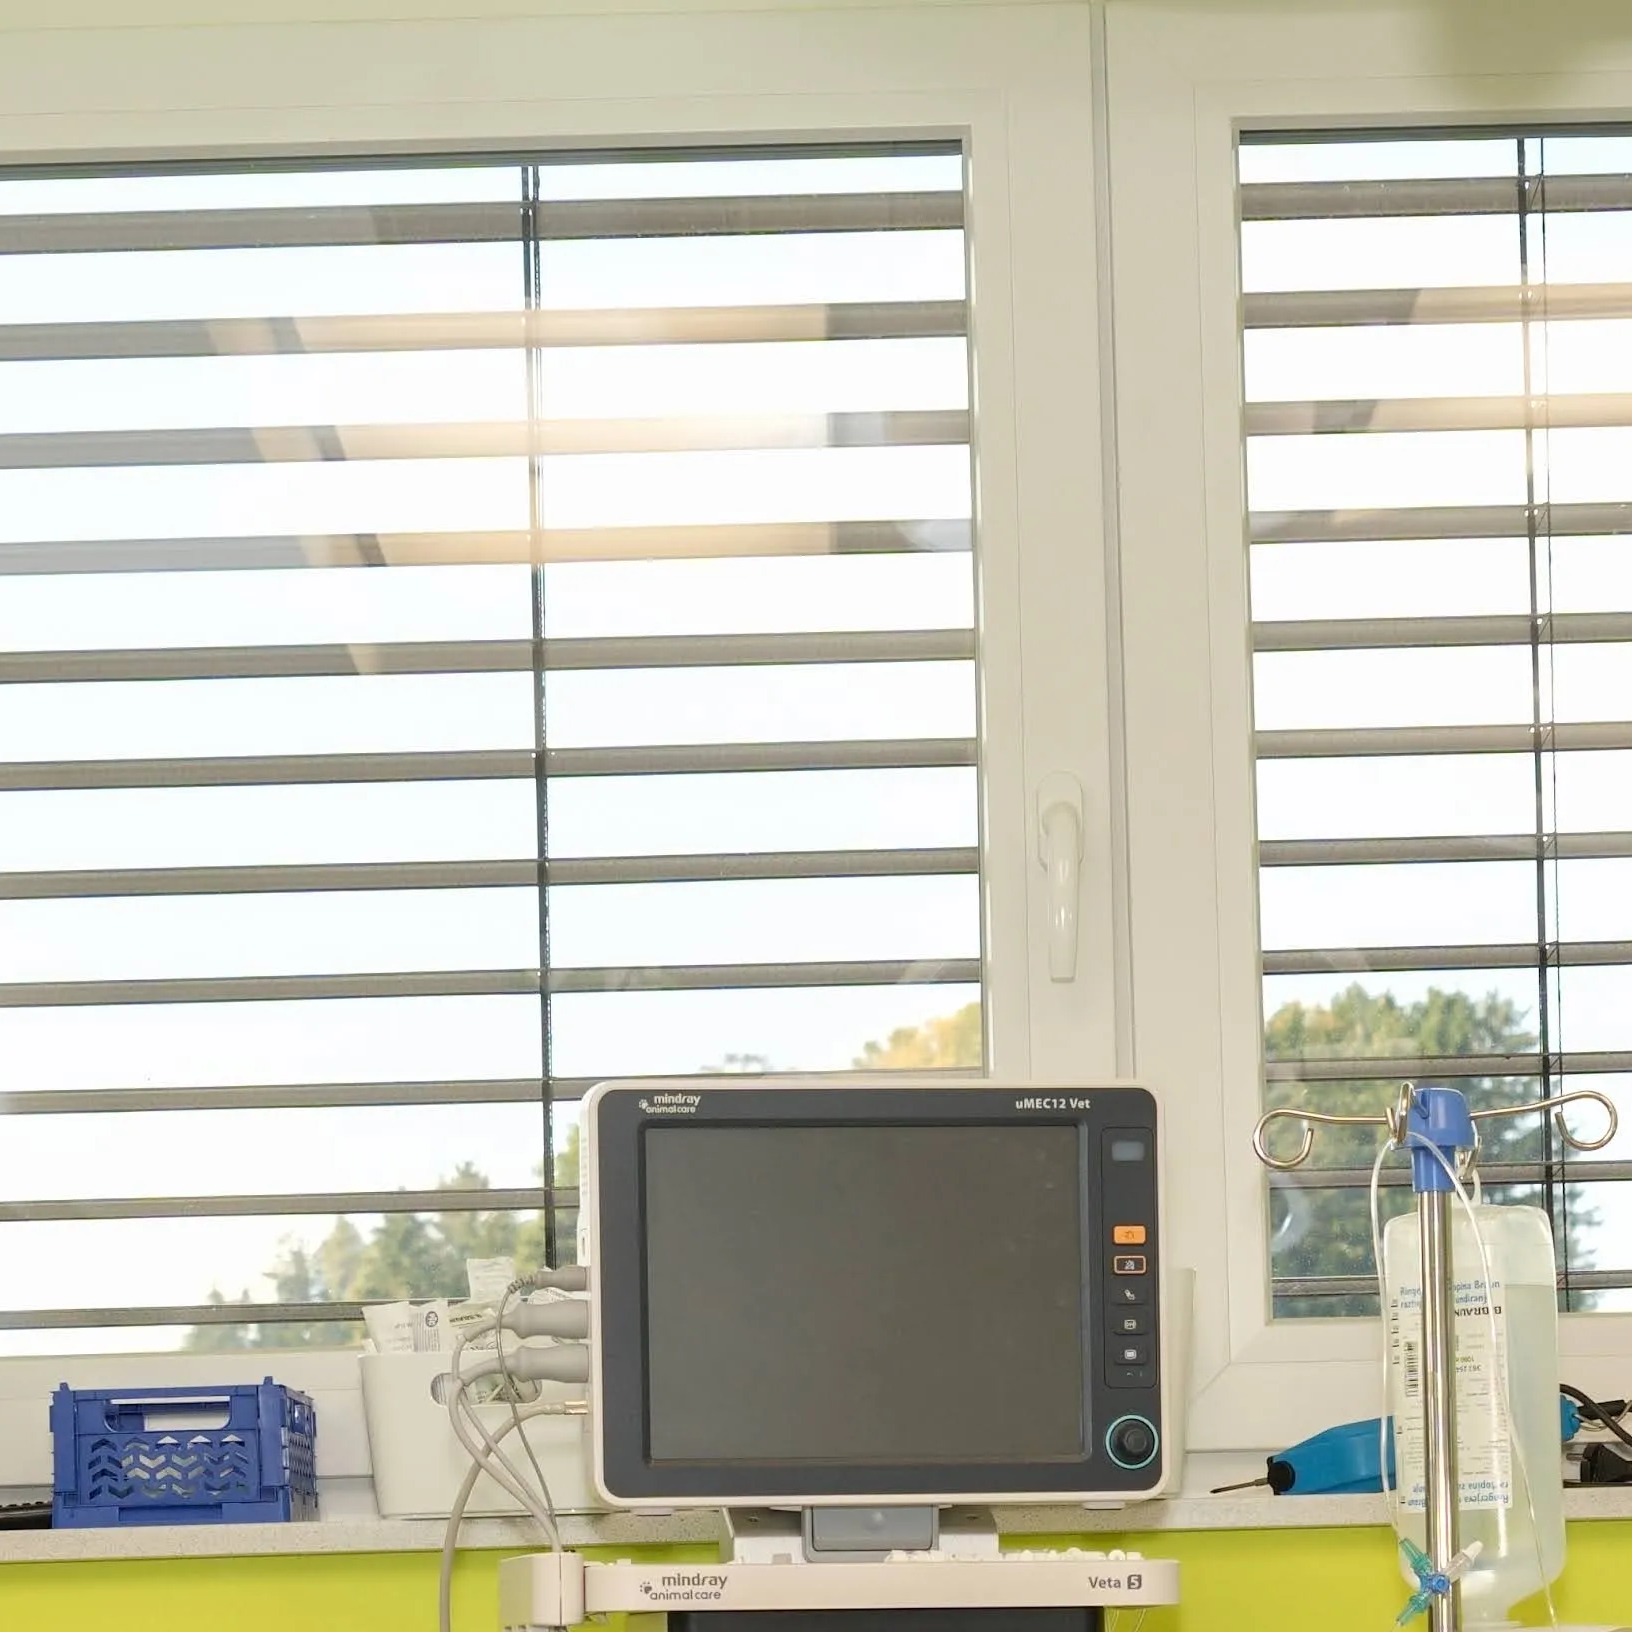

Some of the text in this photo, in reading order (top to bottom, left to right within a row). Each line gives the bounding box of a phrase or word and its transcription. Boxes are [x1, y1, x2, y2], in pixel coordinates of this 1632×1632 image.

[654, 1093, 701, 1106] mindray
[1015, 1097, 1091, 1109] uMEC12 Vet
[662, 1573, 728, 1589] mindray
[1088, 1576, 1122, 1589] Veta
